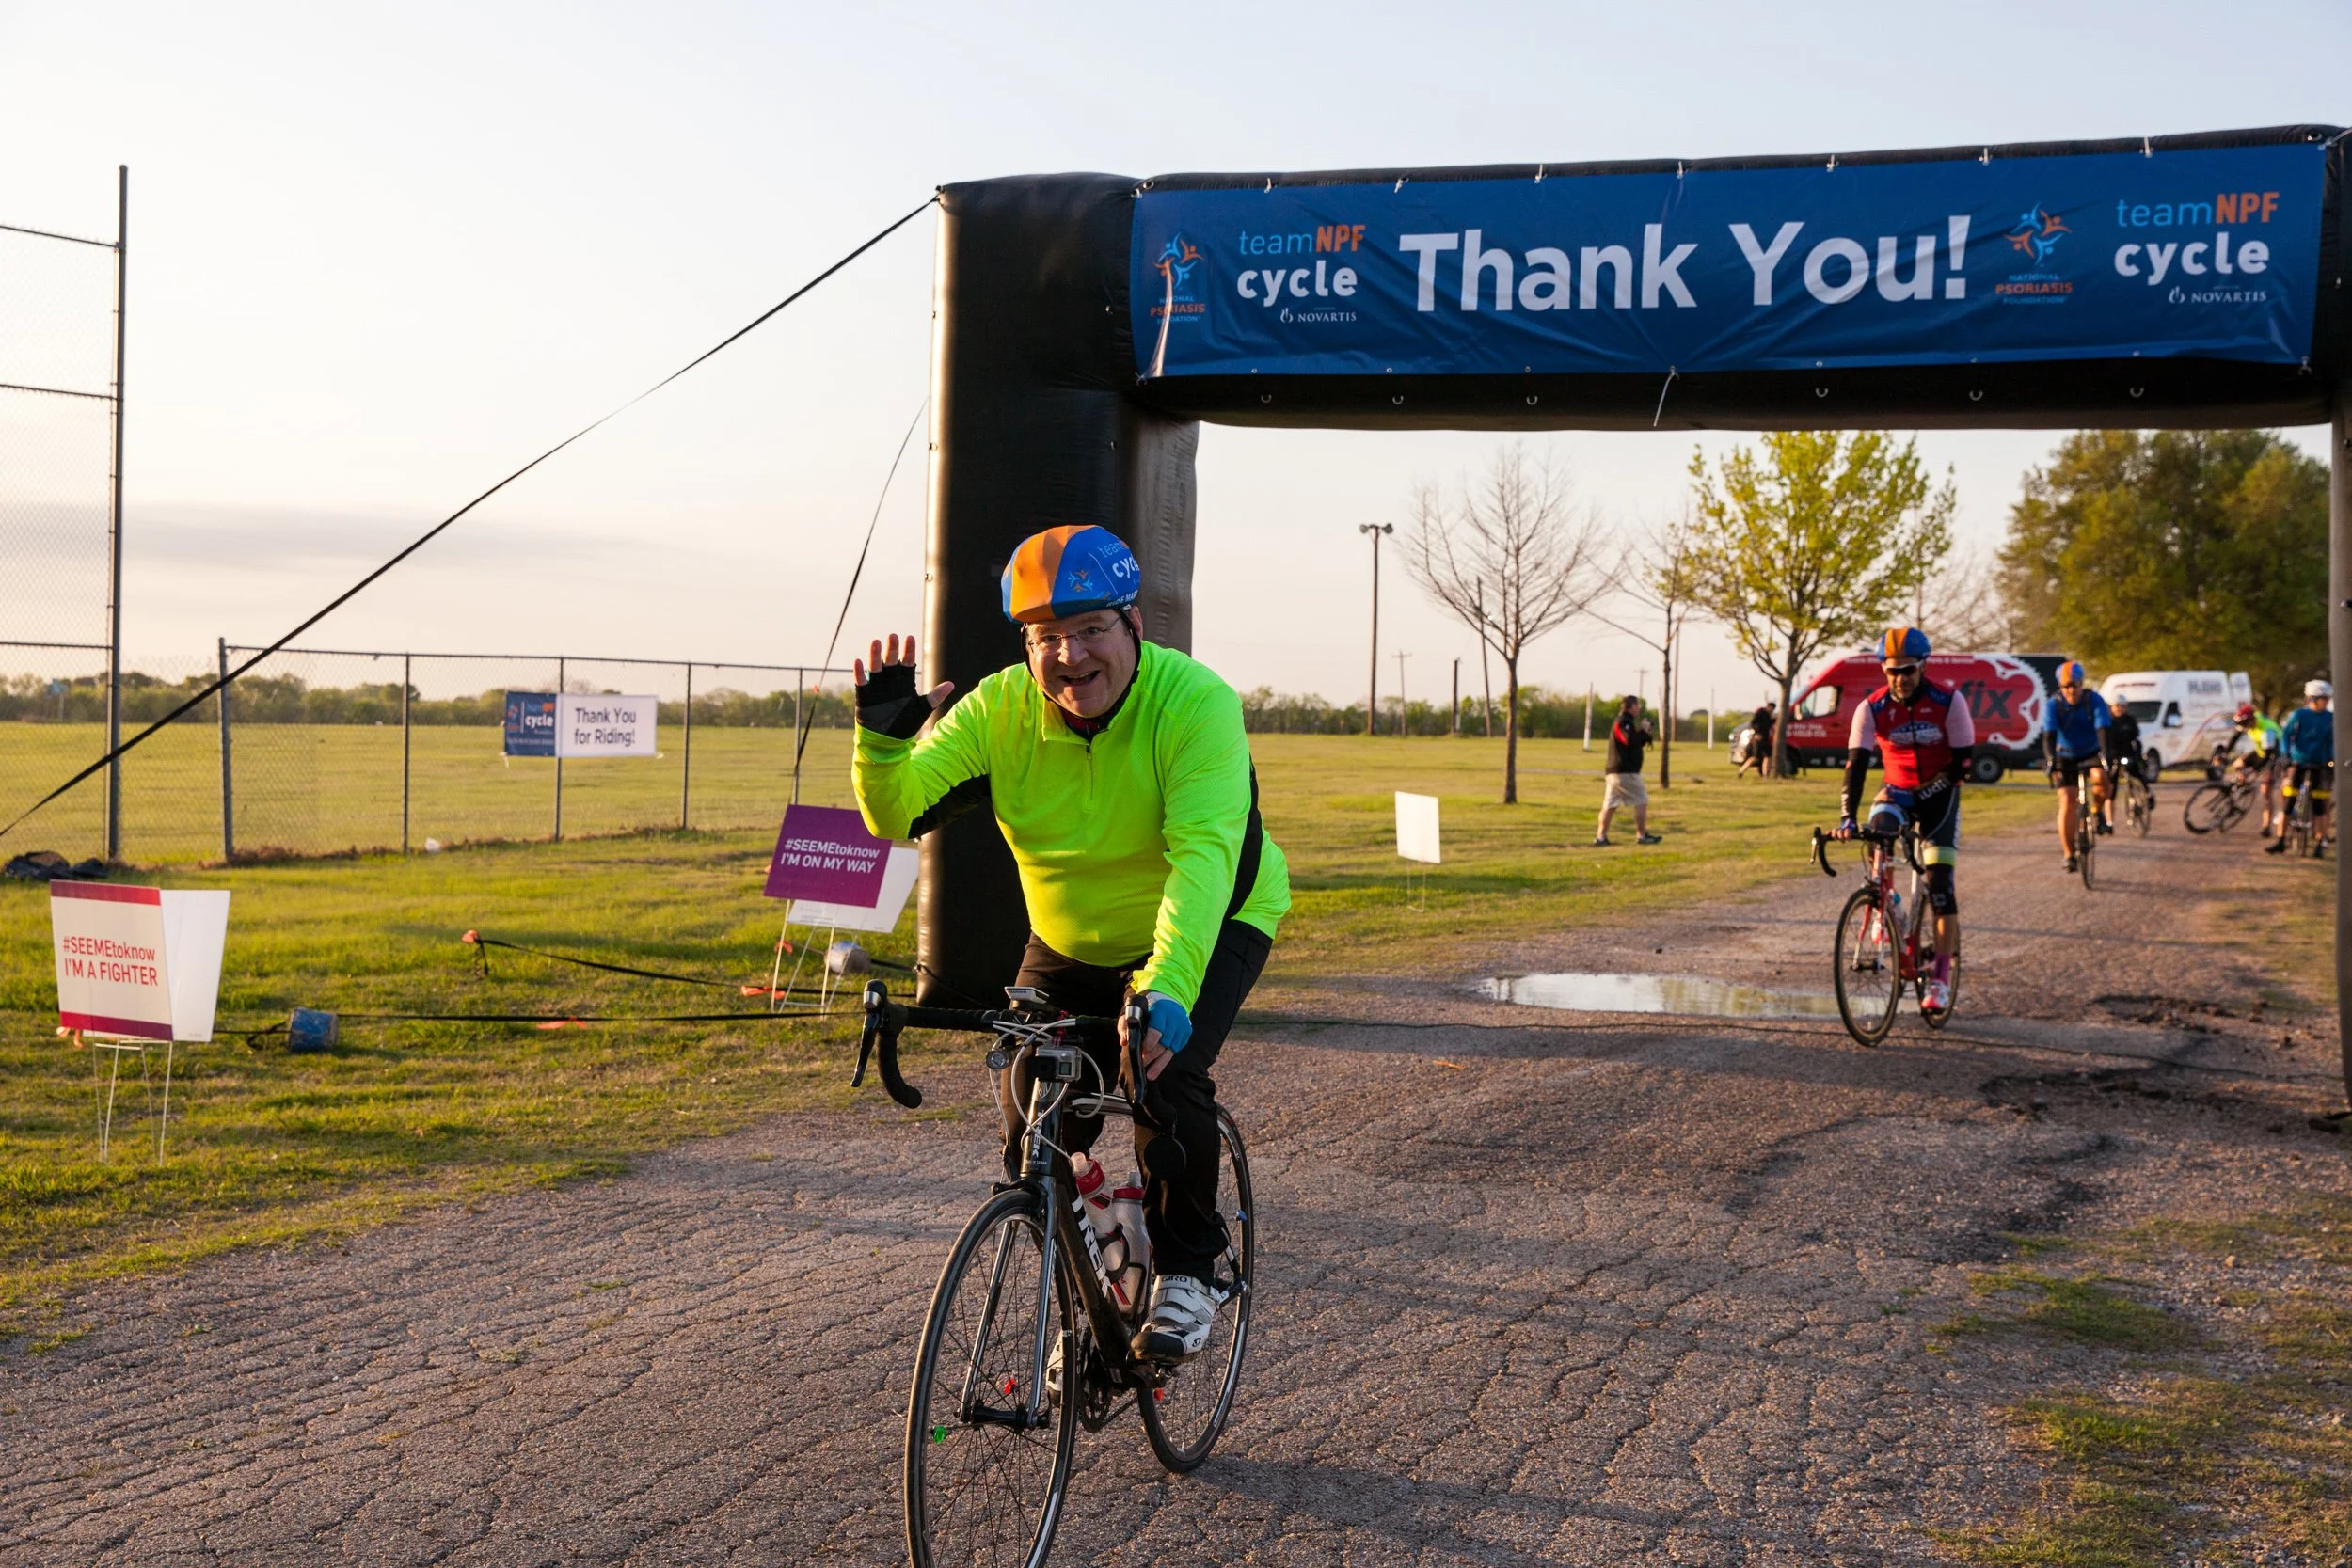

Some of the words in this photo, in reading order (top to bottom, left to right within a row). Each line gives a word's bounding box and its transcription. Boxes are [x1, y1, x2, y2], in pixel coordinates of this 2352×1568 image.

[2116, 191, 2280, 227] teamNPF
[1239, 225, 1366, 255] teamNPF
[1399, 223, 1700, 312] Thank
[1727, 214, 1972, 309] You!
[2114, 231, 2270, 286] cycle
[1237, 260, 1358, 307] cycle
[1995, 282, 2074, 294] PSORIASIS
[2190, 291, 2267, 304] NOVARTIS
[1297, 311, 1357, 323] NOVARTIS
[525, 714, 553, 729] cycle
[575, 708, 611, 723] Thank
[613, 709, 637, 723] You
[574, 728, 591, 744] for
[594, 729, 635, 746] Riding!
[785, 838, 881, 859] #SEEMEtoknow
[780, 853, 802, 866] I'M
[802, 855, 821, 868] ON
[823, 858, 846, 871] MY
[847, 860, 876, 874] WAY
[63, 936, 156, 961] #SEEMEtoknow
[64, 958, 84, 978] I'M
[87, 961, 97, 979] A
[99, 962, 159, 986] FIGHTER
[1161, 1275, 1188, 1283] GIRO
